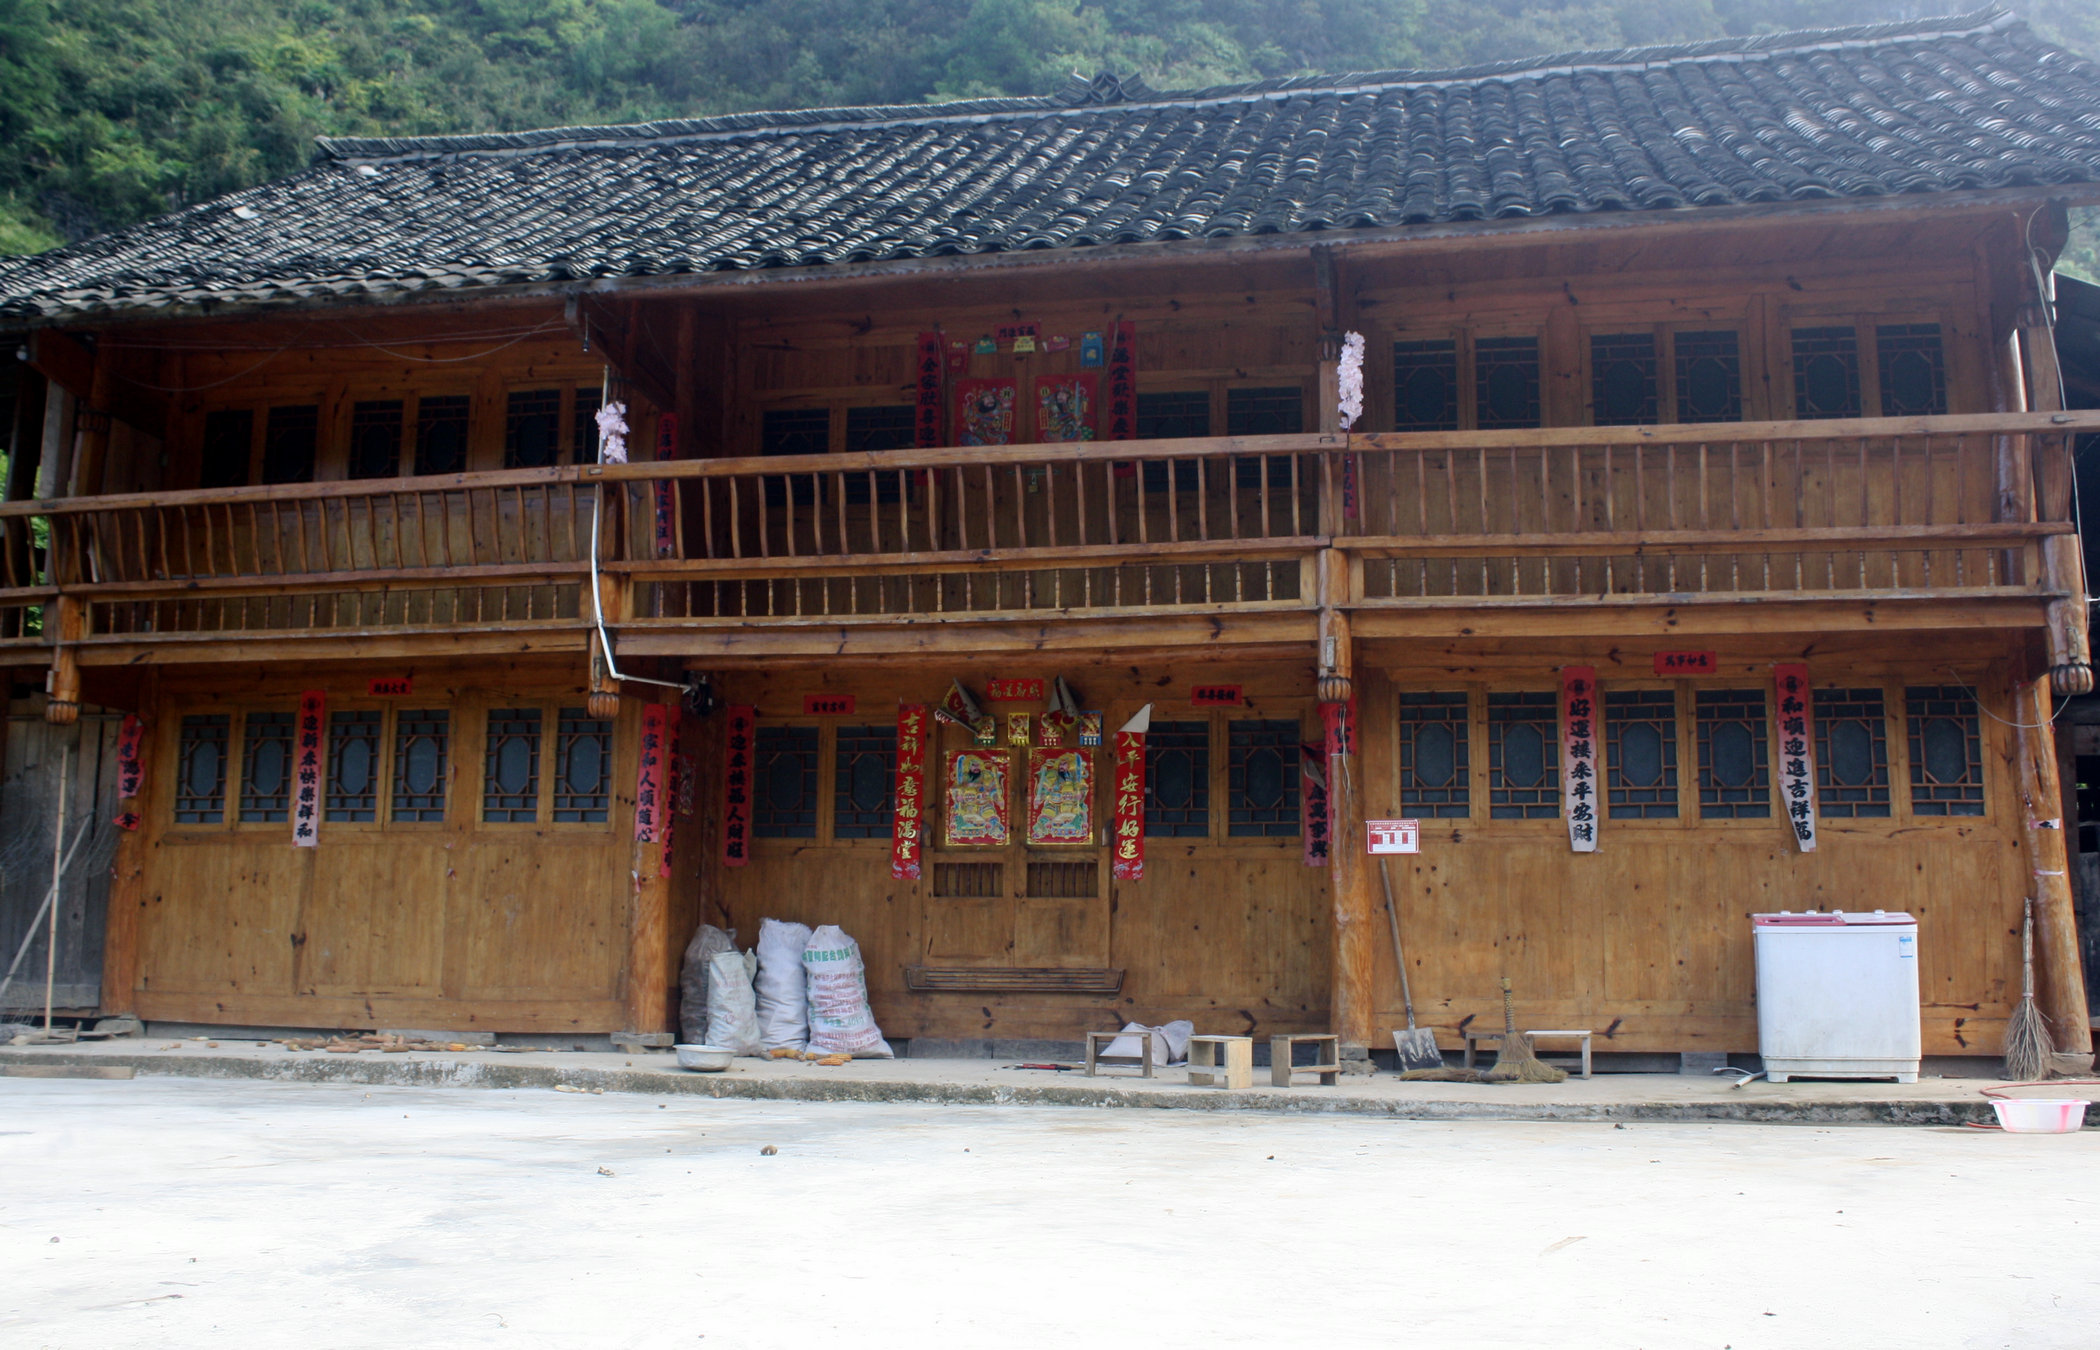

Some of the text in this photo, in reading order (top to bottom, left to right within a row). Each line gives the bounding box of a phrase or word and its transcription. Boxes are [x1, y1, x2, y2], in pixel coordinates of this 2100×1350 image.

[1664, 654, 1708, 667] 萬事如意
[990, 682, 1040, 698] 福星高照
[1197, 688, 1236, 701] 恭喜發財
[896, 711, 921, 860] 吉祥如意福滿堂
[1117, 732, 1142, 860] 入平安行好運
